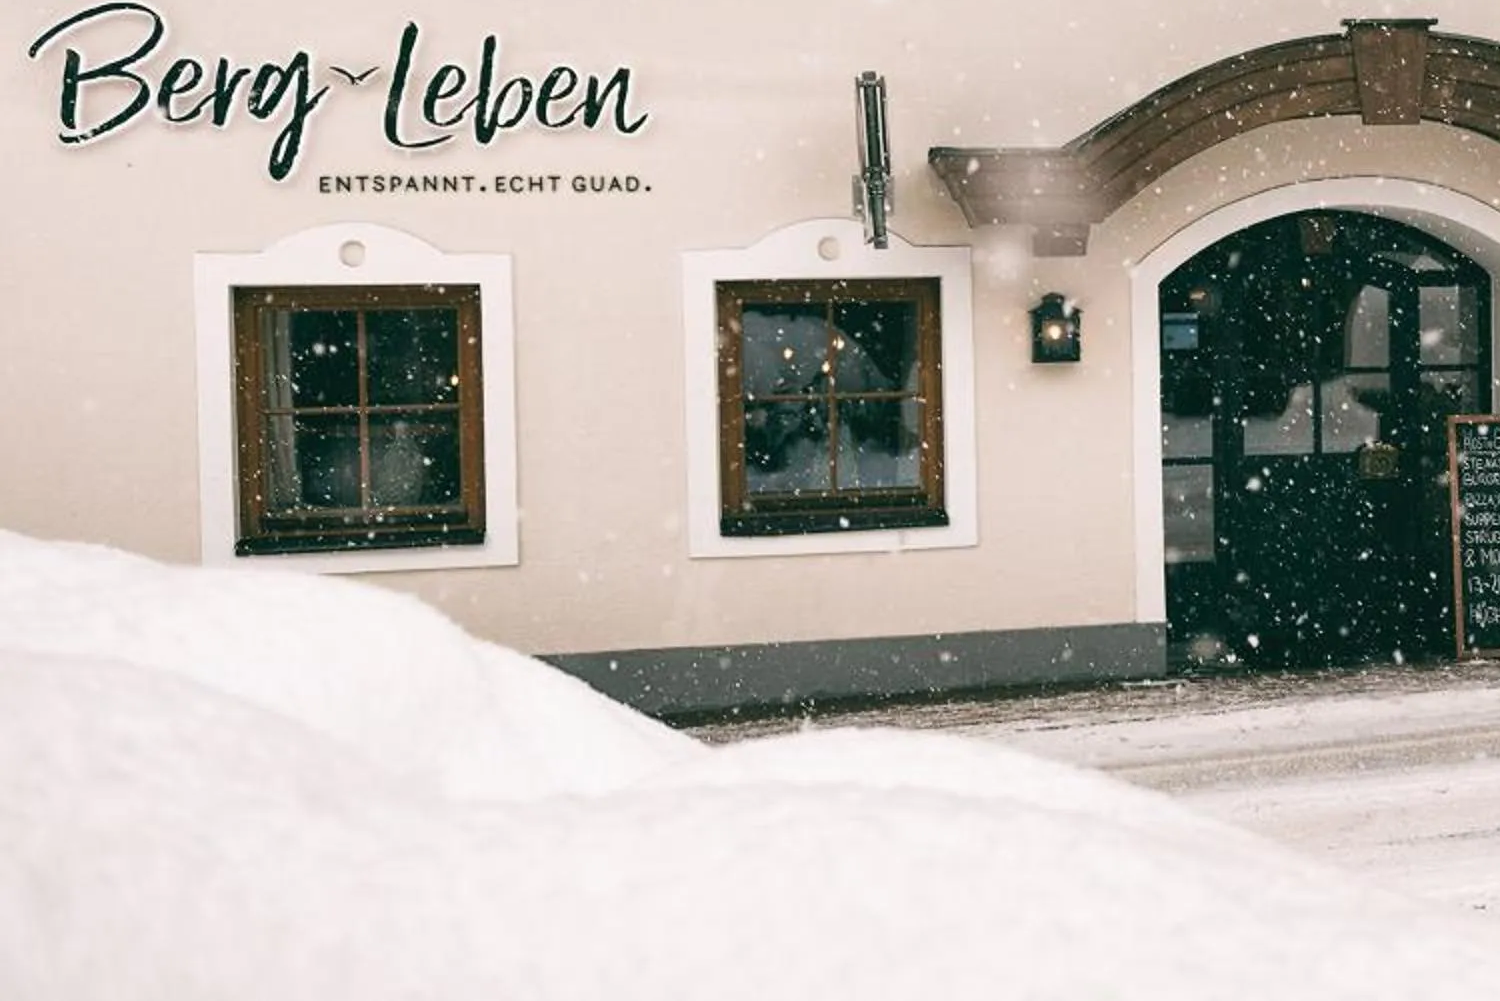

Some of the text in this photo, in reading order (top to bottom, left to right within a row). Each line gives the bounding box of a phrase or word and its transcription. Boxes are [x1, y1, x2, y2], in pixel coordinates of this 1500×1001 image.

[28, 2, 649, 181] Berg Leben
[495, 176, 562, 193] ECHT
[571, 176, 652, 193] GUAD.
